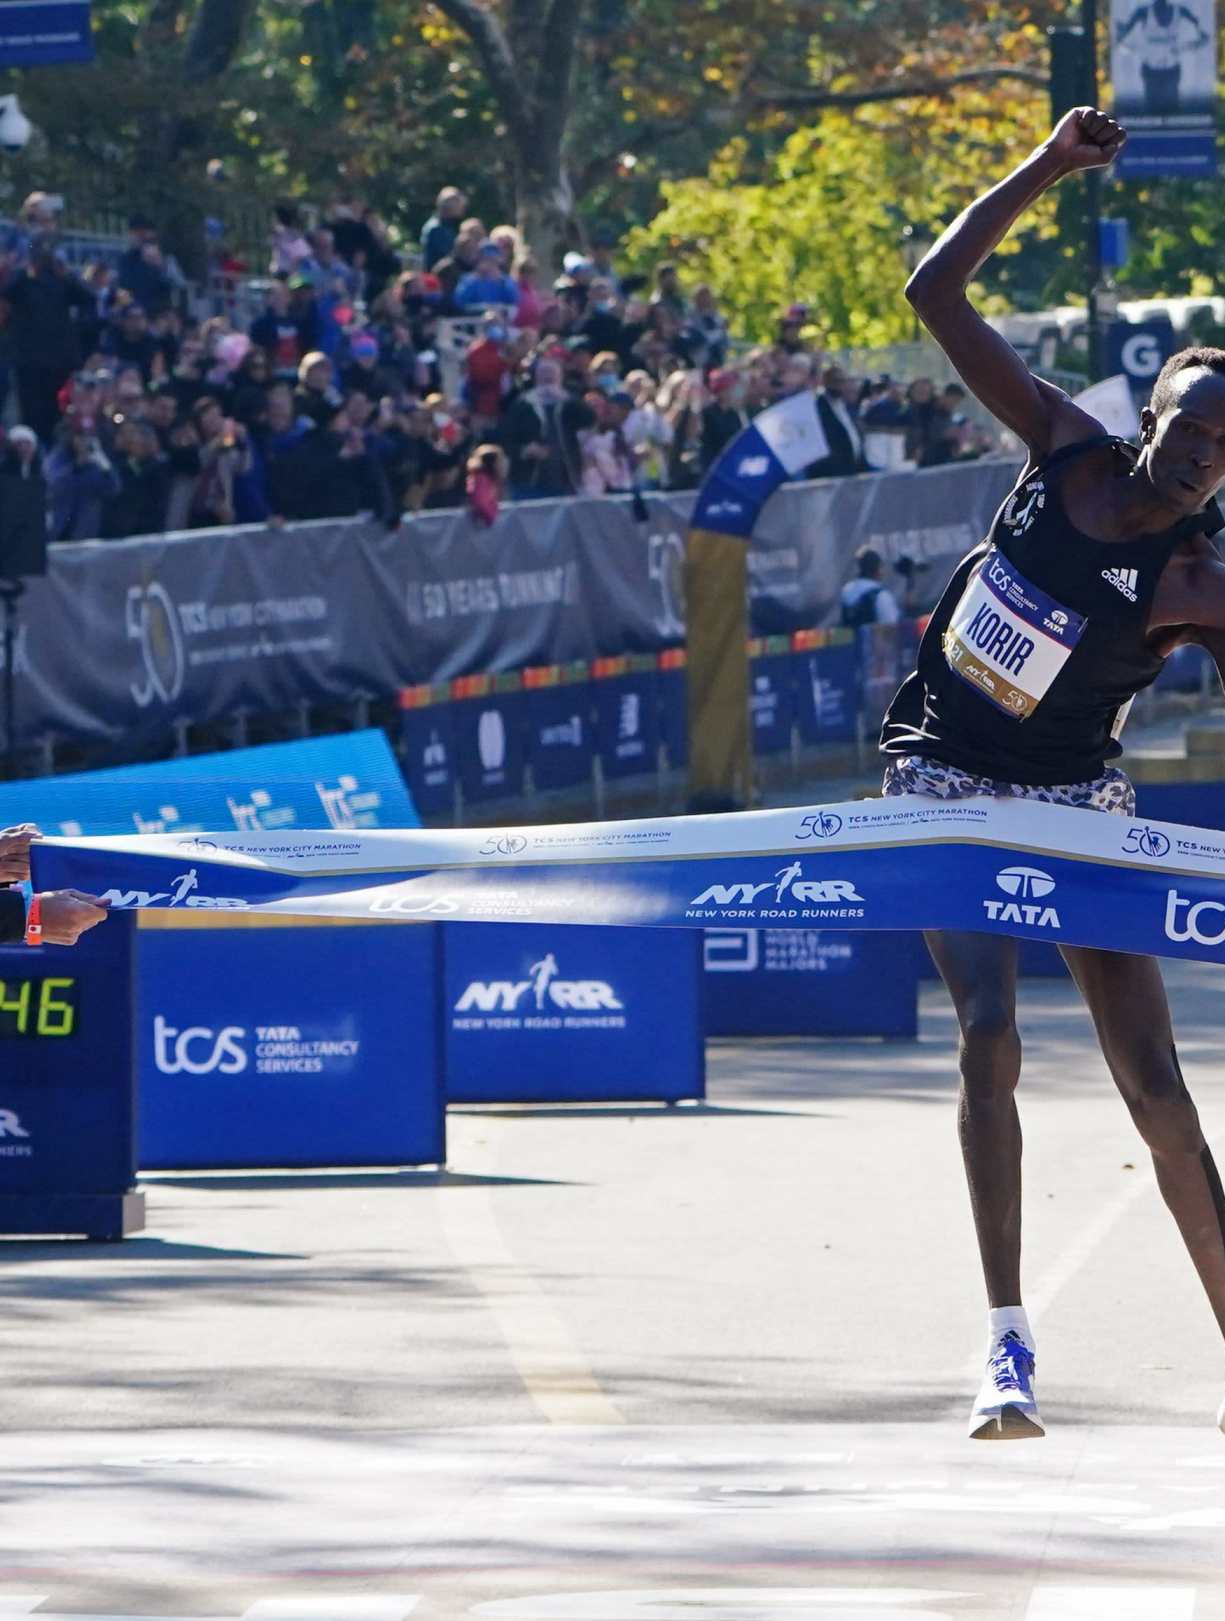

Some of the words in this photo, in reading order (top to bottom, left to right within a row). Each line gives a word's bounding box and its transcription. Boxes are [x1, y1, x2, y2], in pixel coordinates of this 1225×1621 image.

[1120, 334, 1162, 377] G
[988, 557, 1012, 592] tcs
[1101, 569, 1138, 602] adidas
[1042, 617, 1065, 636] TATA
[966, 602, 1035, 677] KORIR
[849, 815, 869, 823] TCS
[892, 812, 915, 820] YORK
[916, 810, 936, 818] CITY
[937, 808, 988, 816] MARATHON
[623, 831, 672, 839] MARATHON
[1176, 840, 1198, 850] TCS
[1199, 844, 1222, 854] NEW
[685, 909, 718, 918] NEW
[720, 909, 757, 918] YORK
[759, 909, 798, 918] ROAD
[801, 908, 865, 918] RUNNERS
[983, 899, 1062, 929] TATA
[255, 1026, 301, 1041] TATA
[154, 1015, 248, 1075] tcs
[255, 1040, 360, 1058] CONSULTANCY
[256, 1057, 323, 1073] SERVICES
